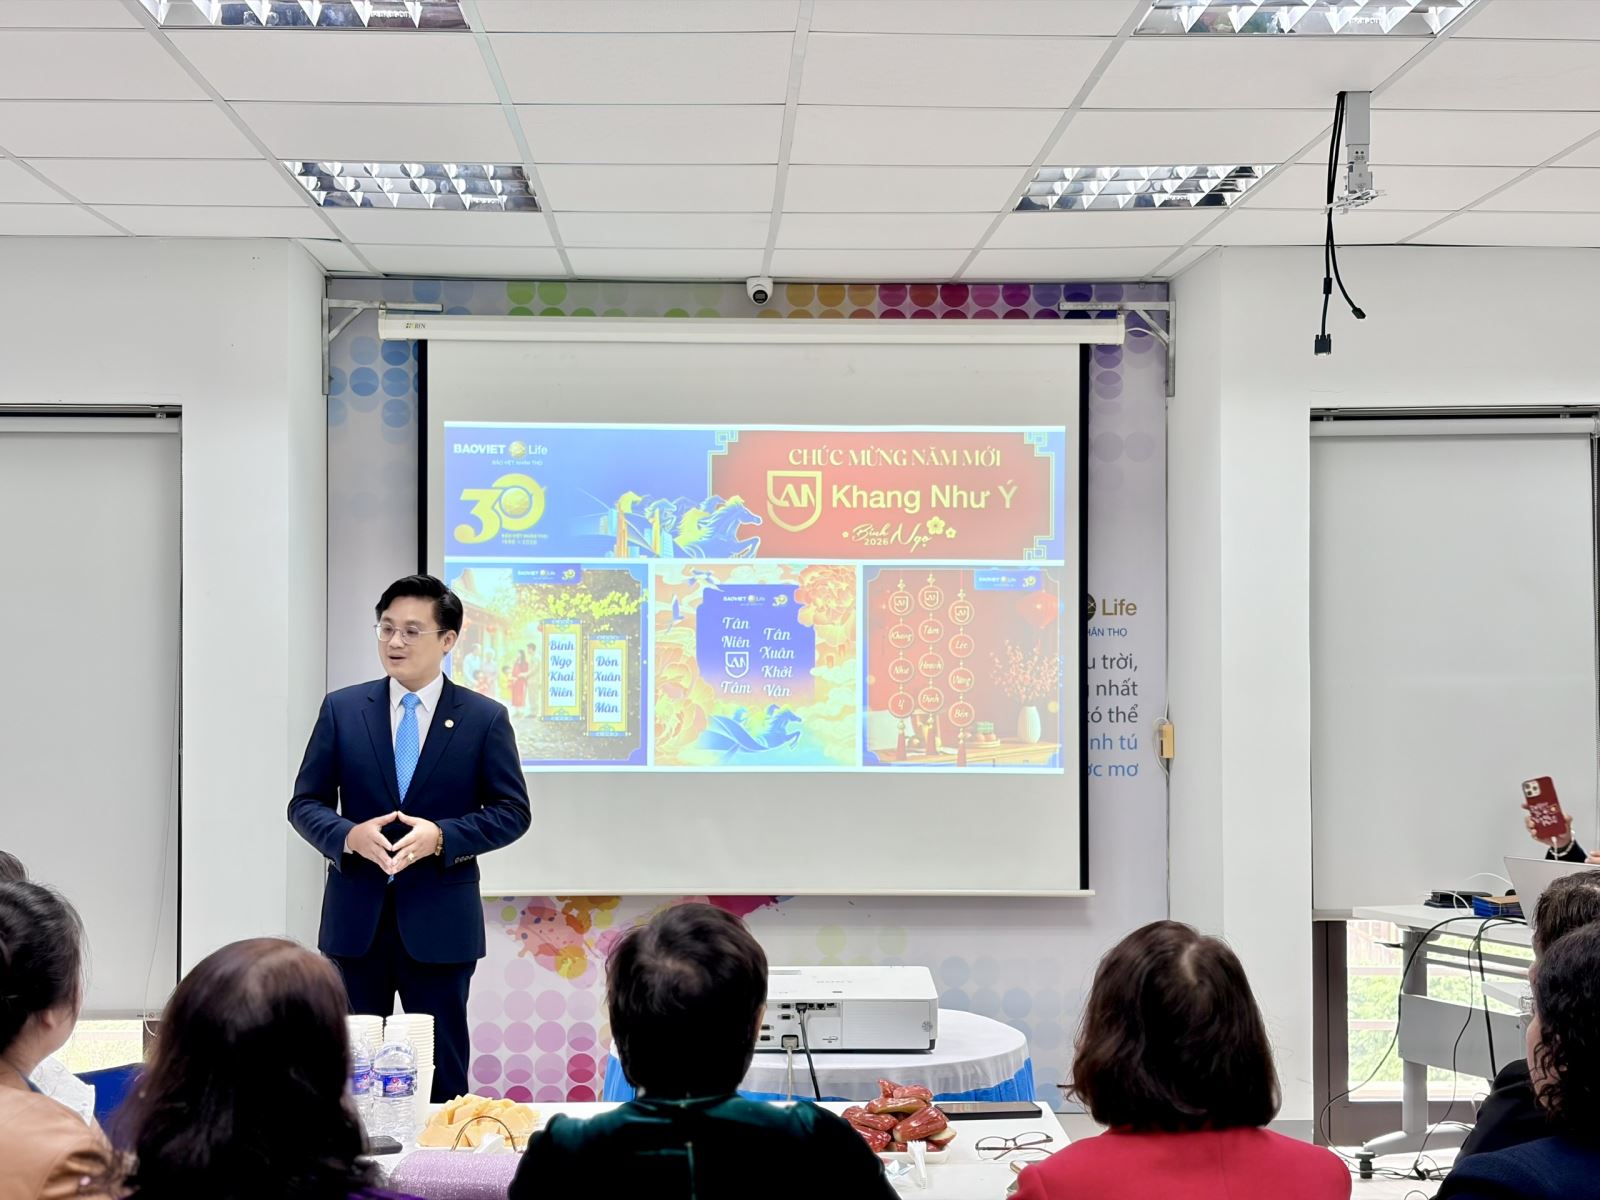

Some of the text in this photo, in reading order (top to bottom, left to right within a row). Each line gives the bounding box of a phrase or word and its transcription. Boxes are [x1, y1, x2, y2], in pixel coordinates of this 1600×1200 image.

[453, 443, 548, 455] BAOVIET Life
[788, 445, 1001, 466] CHÚC MỪNG NĂM MỚI
[832, 485, 921, 514] Khang
[931, 485, 990, 508] Như
[998, 479, 1018, 509] Ý
[454, 473, 546, 544] 30
[864, 538, 889, 546] 2026
[1102, 598, 1137, 616] Life
[722, 617, 750, 630] Tân
[763, 627, 791, 641] Tân
[1108, 627, 1127, 638] THỌ
[721, 636, 750, 648] Niên
[759, 646, 795, 659] Xuân
[551, 655, 572, 669] Ngọ
[1101, 652, 1137, 672] trời,
[548, 671, 574, 681] Khai
[594, 671, 621, 681] Xuân
[549, 687, 573, 697] Niên
[720, 681, 752, 694] Tâm
[1096, 677, 1138, 696] nhất
[1107, 703, 1138, 723] thể
[1118, 733, 1137, 750] tú
[1108, 762, 1138, 777] mơ
